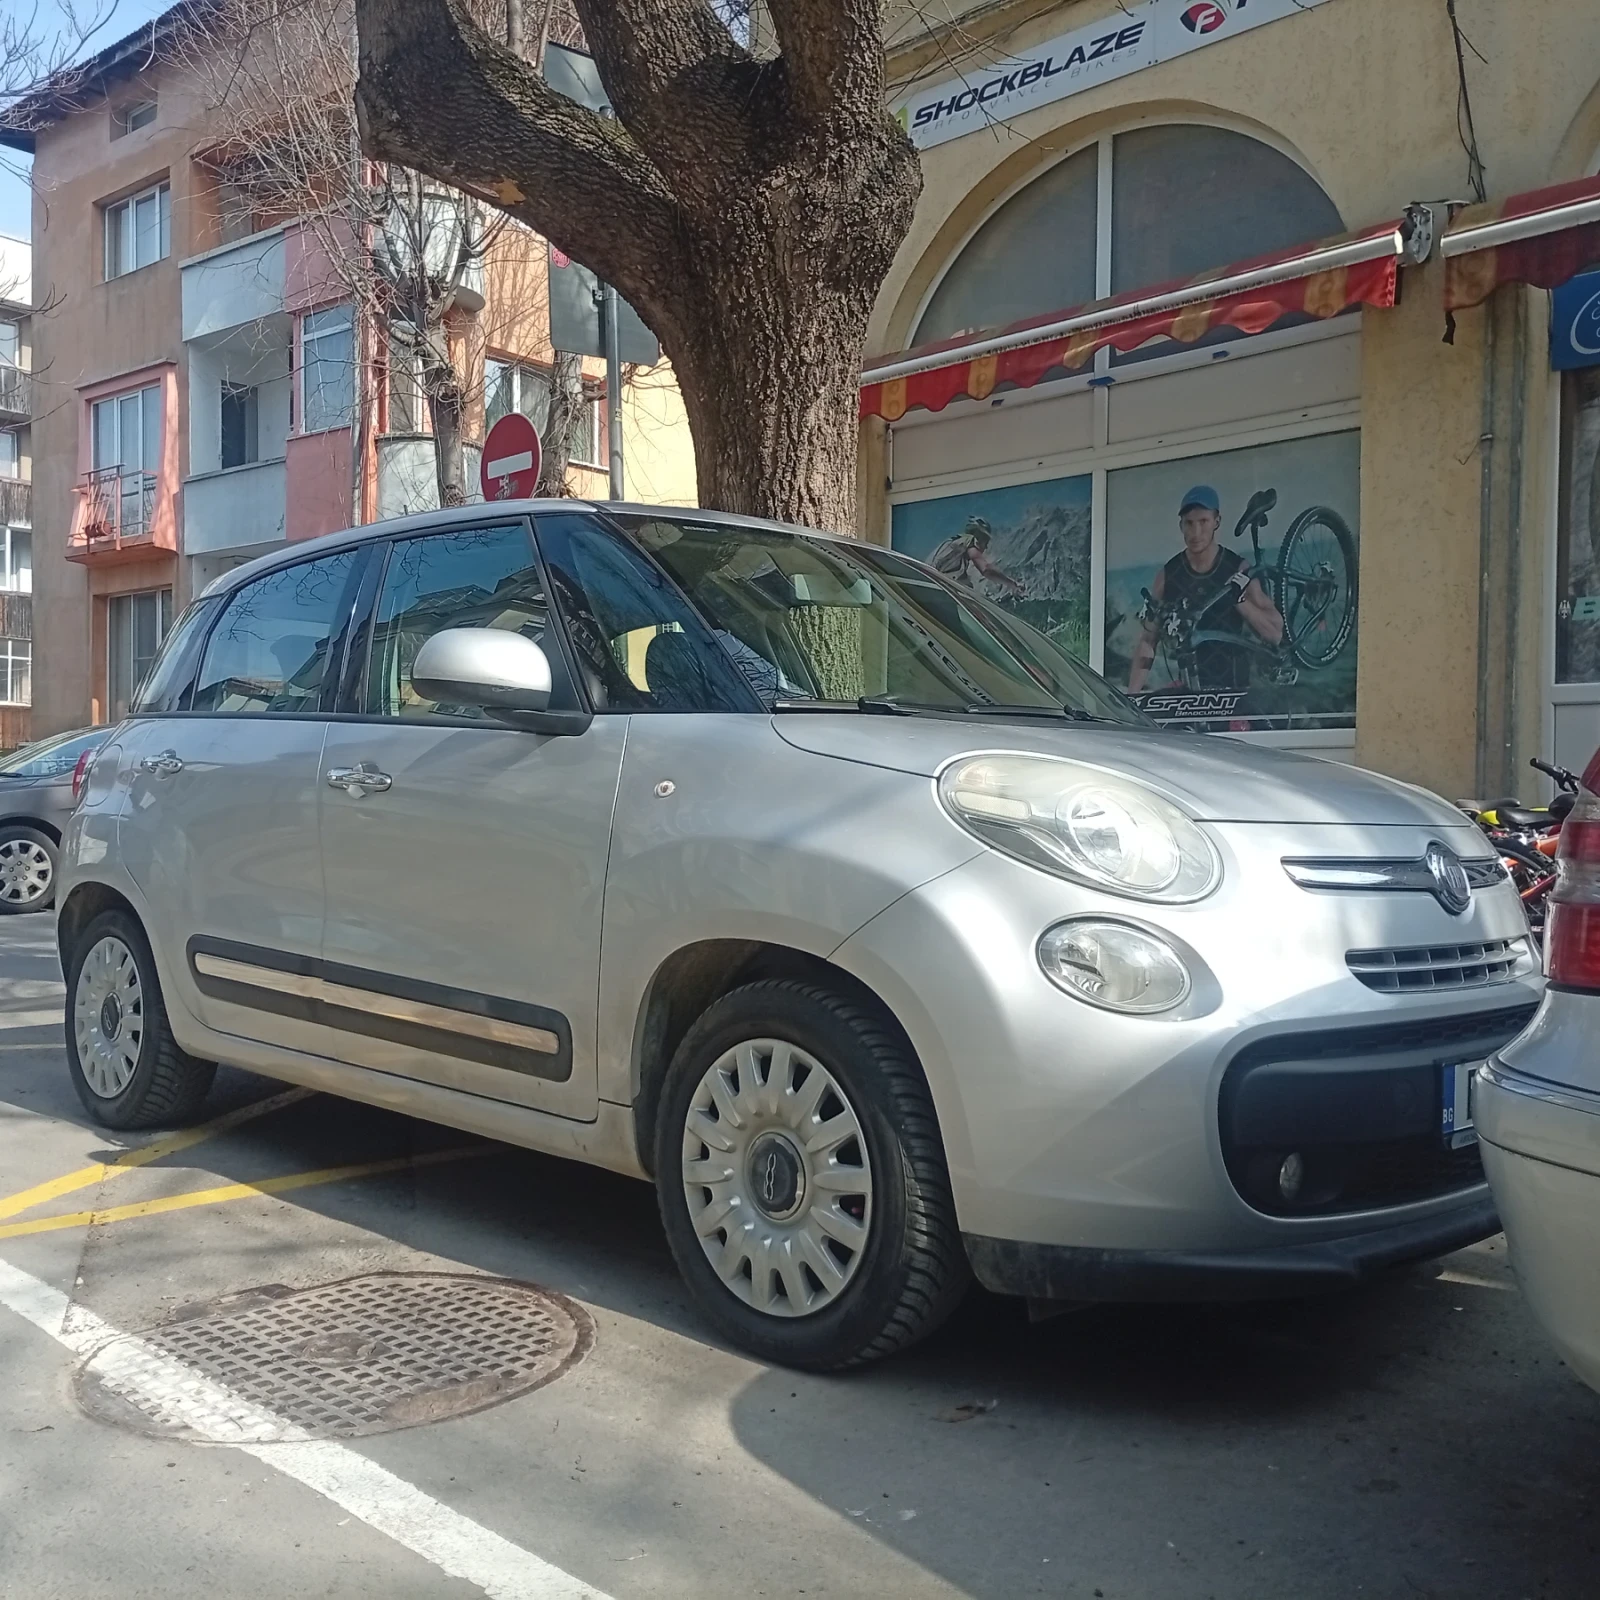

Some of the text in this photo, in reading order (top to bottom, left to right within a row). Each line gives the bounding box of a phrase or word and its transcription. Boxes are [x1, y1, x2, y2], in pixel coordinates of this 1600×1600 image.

[912, 20, 1146, 129] SHOCKBLAZE
[1070, 48, 1137, 79] BIKES
[1143, 692, 1248, 711] SPRINT
[1442, 1107, 1454, 1124] BG
